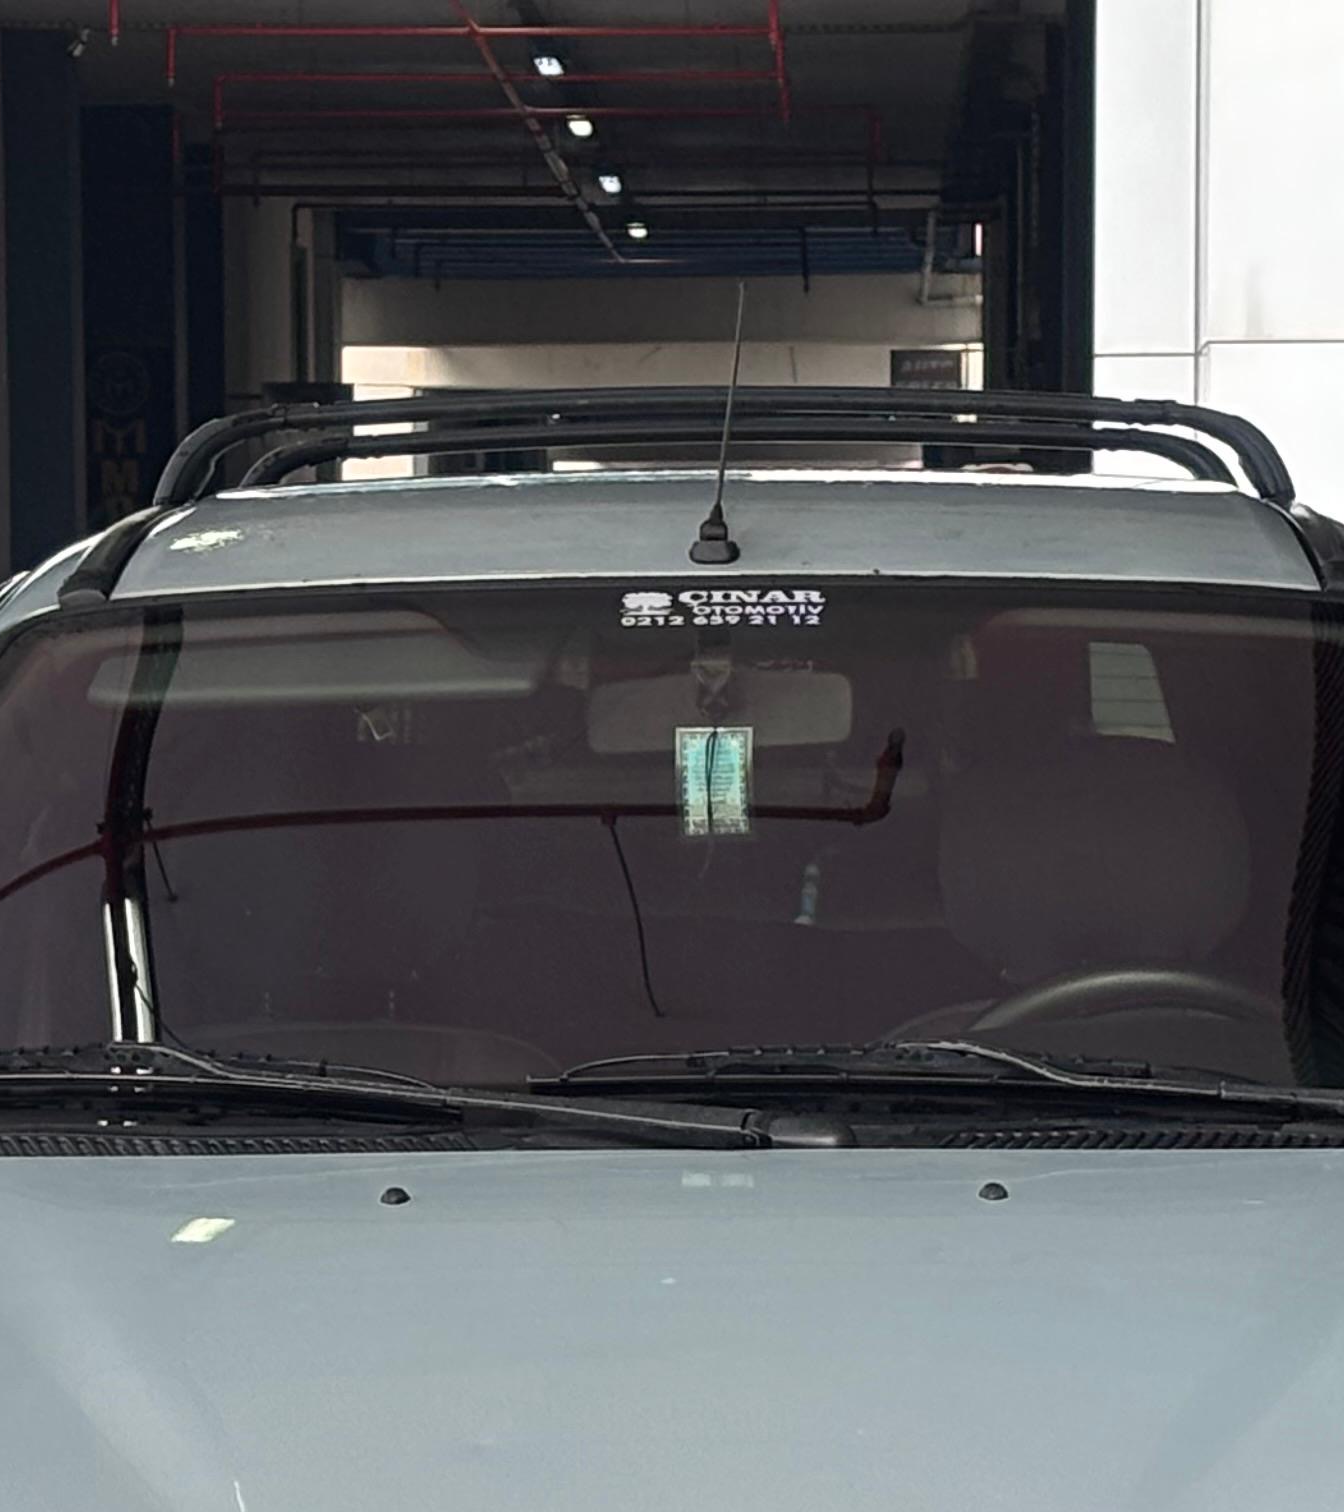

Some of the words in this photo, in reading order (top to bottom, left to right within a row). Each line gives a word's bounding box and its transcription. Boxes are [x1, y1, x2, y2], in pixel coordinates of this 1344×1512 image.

[693, 604, 824, 615] OTOMOTİV
[621, 615, 685, 626] 0212
[693, 615, 741, 626] 659
[748, 615, 777, 626] 21
[792, 615, 821, 626] 12
